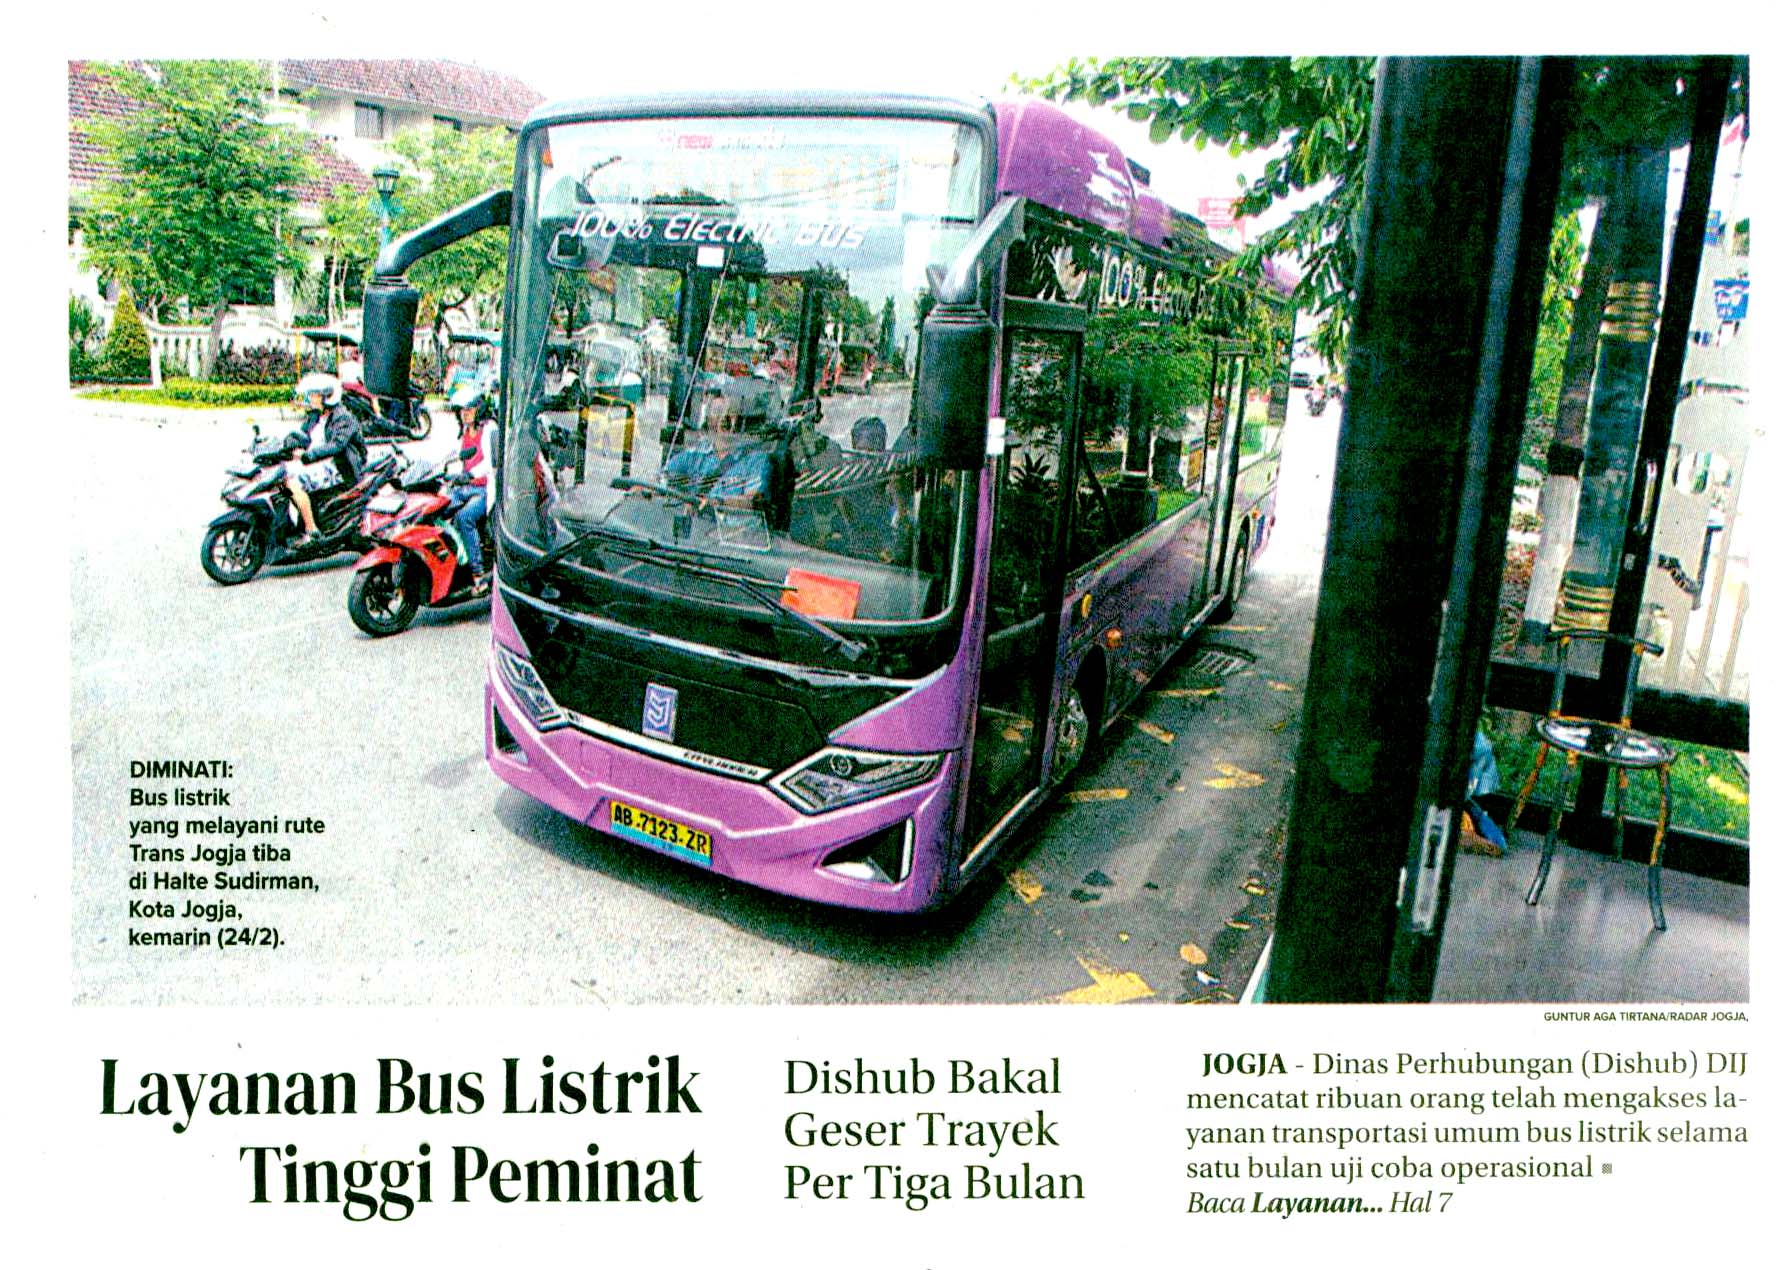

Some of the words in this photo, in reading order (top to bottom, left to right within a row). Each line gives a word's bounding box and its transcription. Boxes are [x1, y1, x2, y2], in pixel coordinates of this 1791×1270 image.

[570, 208, 653, 240] 100%
[130, 760, 233, 779] DIMINATI:
[129, 787, 168, 807] Bus
[174, 787, 231, 807] listrik
[129, 819, 179, 839] yang
[185, 815, 279, 839] melayani
[284, 816, 326, 834] rute
[128, 843, 185, 862] Trans
[190, 843, 246, 867] Jogja
[251, 842, 291, 862] tiba
[128, 871, 147, 890] di
[153, 871, 209, 890] Halte
[214, 870, 320, 893] Sudirman,
[129, 899, 175, 919] Kota
[181, 898, 243, 923] Jogja,
[128, 927, 211, 947] kemarin
[217, 926, 285, 950] (24/2).
[1543, 1011, 1590, 1022] GUNTUR
[1593, 1011, 1617, 1022] AGA
[1619, 1011, 1708, 1022] TIRTANA/RADAR
[784, 1057, 936, 1095] Dishub
[948, 1057, 1061, 1095] Bakal
[1202, 1053, 1287, 1077] JOGJA
[1313, 1053, 1388, 1074] Dinas
[1397, 1051, 1572, 1080] Perhubungan
[1581, 1051, 1698, 1078] (Dishub)
[1707, 1052, 1746, 1076] DIJ
[99, 1058, 358, 1134] Layanan
[375, 1058, 485, 1115] Bus
[502, 1054, 703, 1115] Listrik
[1187, 1090, 1308, 1109] mencatat
[1316, 1086, 1402, 1109] ribuan
[1410, 1093, 1485, 1115] orang
[1492, 1085, 1555, 1108] telah
[1564, 1085, 1707, 1115] mengakses
[1715, 1085, 1748, 1108] la-
[784, 1111, 906, 1147] Geser
[916, 1109, 1060, 1158] Trayek
[1186, 1127, 1265, 1150] yanan
[1272, 1122, 1427, 1150] transportasi
[1435, 1127, 1519, 1143] umum
[1527, 1120, 1572, 1143] bus
[1579, 1120, 1651, 1143] listrik
[1657, 1120, 1748, 1143] selama
[239, 1142, 433, 1222] Tinggi
[451, 1143, 703, 1204] Peminat
[1186, 1160, 1240, 1178] satu
[1248, 1155, 1322, 1178] bulan
[1331, 1156, 1363, 1185] uji
[1371, 1155, 1433, 1179] coba
[1441, 1155, 1592, 1185] operasional
[784, 1165, 854, 1200] Per
[863, 1165, 952, 1212] Tiga
[964, 1162, 1085, 1200] Bulan
[1187, 1191, 1245, 1214] Baca
[1251, 1191, 1383, 1220] Layanan...
[1390, 1190, 1433, 1213] Hal
[1439, 1192, 1454, 1213] 7
